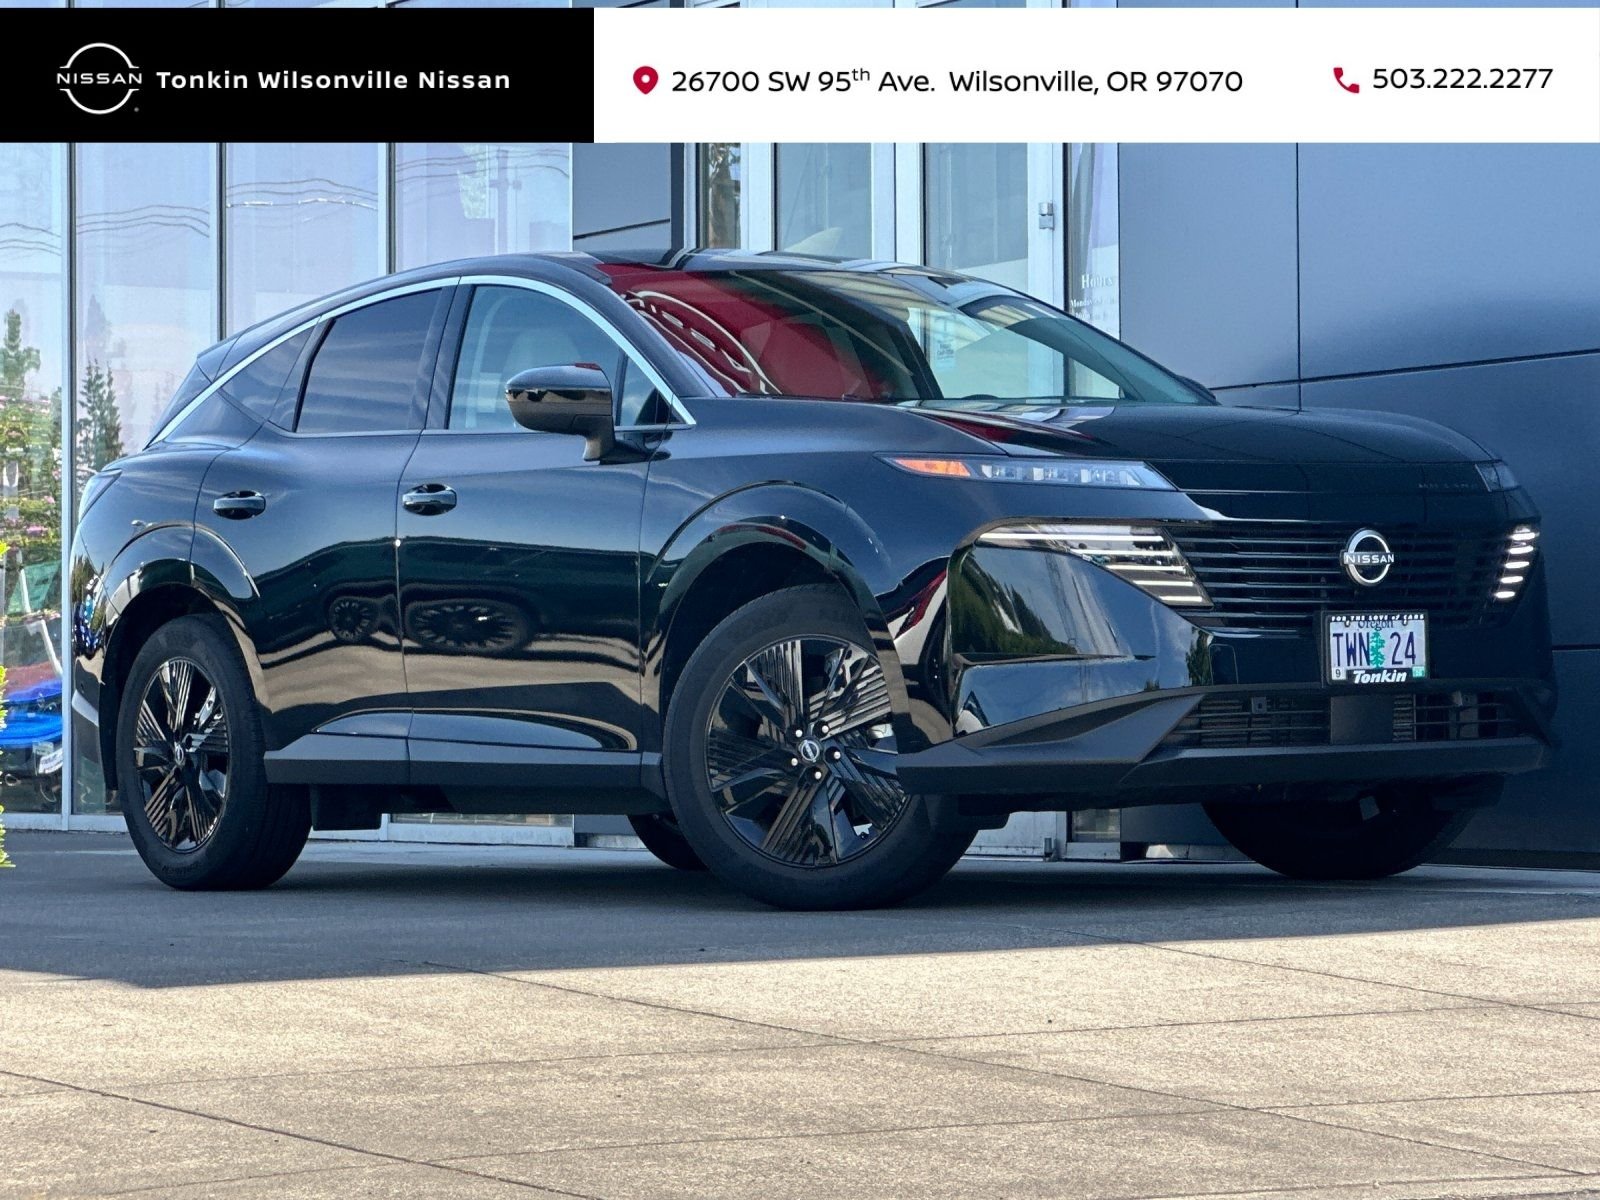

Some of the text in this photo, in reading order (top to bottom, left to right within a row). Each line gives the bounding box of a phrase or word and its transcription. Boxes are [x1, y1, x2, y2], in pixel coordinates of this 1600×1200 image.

[1344, 553, 1395, 565] NISSAN
[1358, 620, 1394, 631] Oregon
[1332, 631, 1416, 667] TWN 24
[1353, 669, 1408, 684] Tonkin
